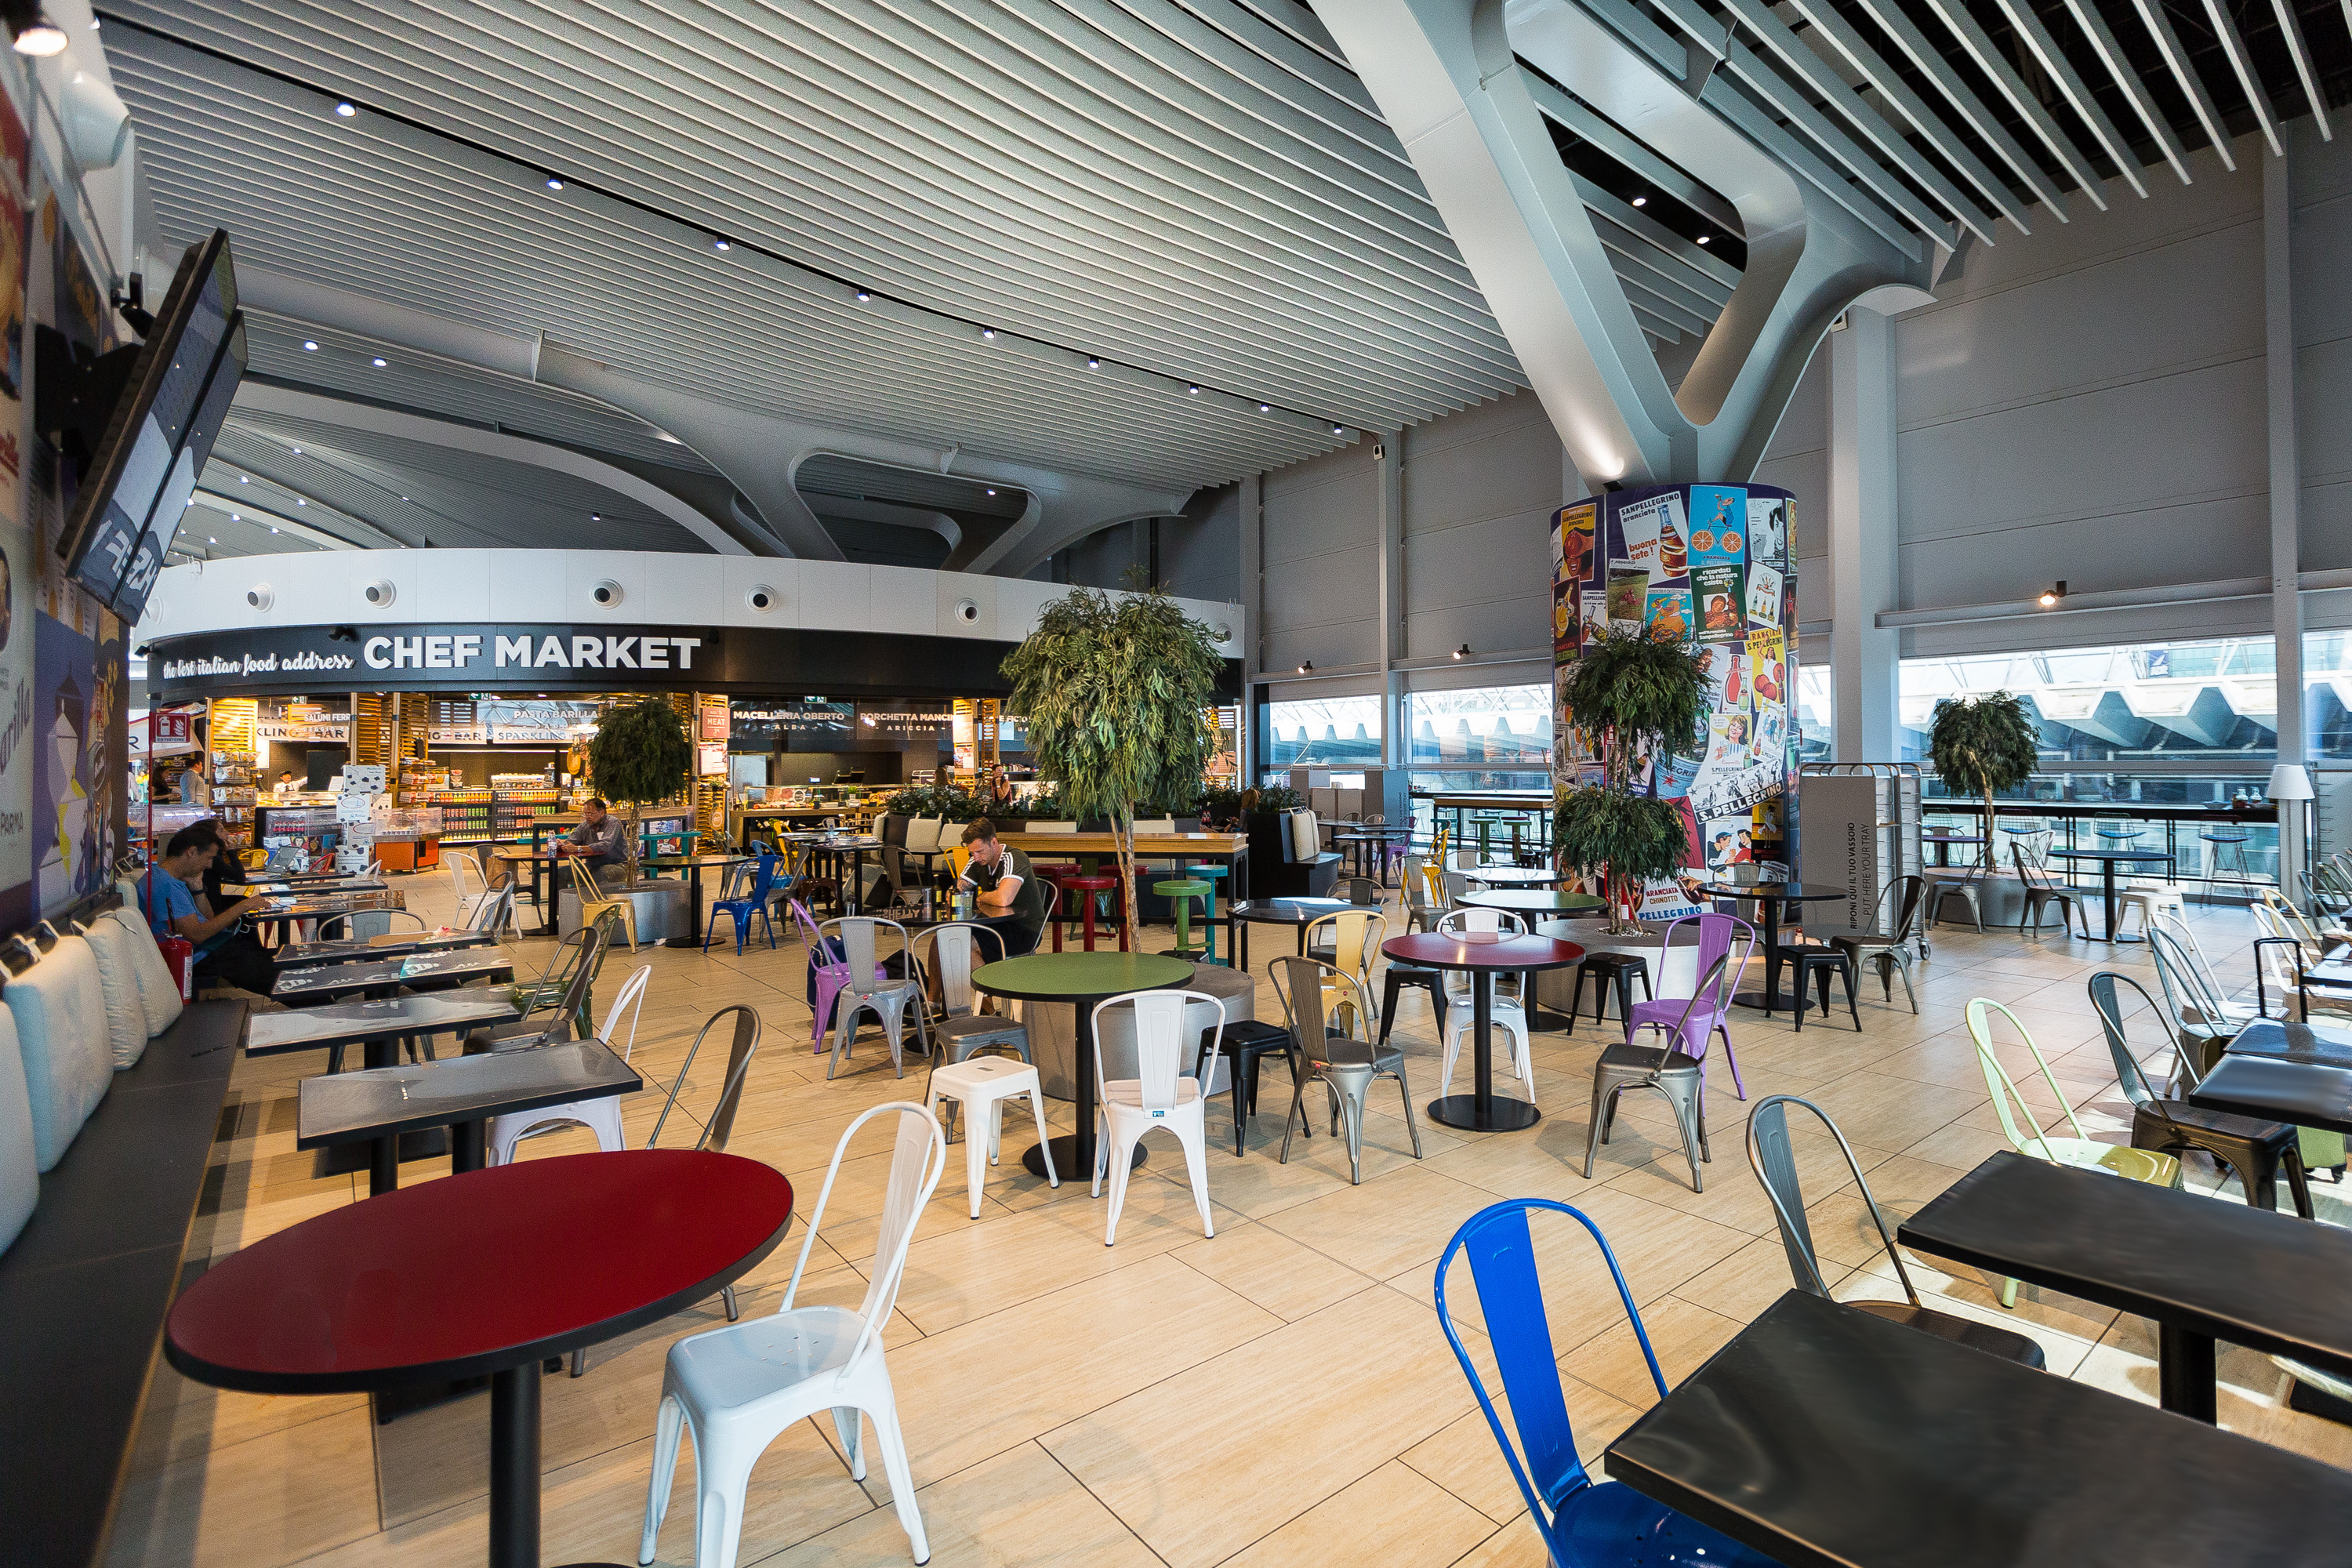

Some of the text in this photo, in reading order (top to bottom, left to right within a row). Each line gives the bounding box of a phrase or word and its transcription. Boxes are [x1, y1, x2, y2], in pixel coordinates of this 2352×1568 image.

[1621, 492, 1679, 517] SANPELLEGRINO
[1623, 508, 1656, 523] aranciata
[1628, 538, 1658, 553] buona
[1702, 567, 1731, 575] ricordati
[363, 635, 701, 670] CHEF MARKET
[163, 661, 177, 679] the
[197, 655, 242, 676] italian
[242, 652, 278, 677] food
[282, 651, 355, 671] address
[514, 710, 551, 719] PASTA
[733, 711, 800, 720] MACELLERIA
[803, 712, 845, 720] OBERTO
[860, 713, 919, 721] PORCHETTA
[707, 717, 725, 726] MEAT
[499, 731, 567, 741] SPARKLING
[1, 810, 24, 837] PARMA
[1848, 822, 1857, 857] VASSOIO
[1861, 823, 1872, 916] PUT HERE YOUR TRAY
[1849, 877, 1857, 885] IL
[1646, 887, 1679, 898] ARANCIATA
[1849, 886, 1857, 901] QUI
[1649, 895, 1679, 905] CHINOTTO
